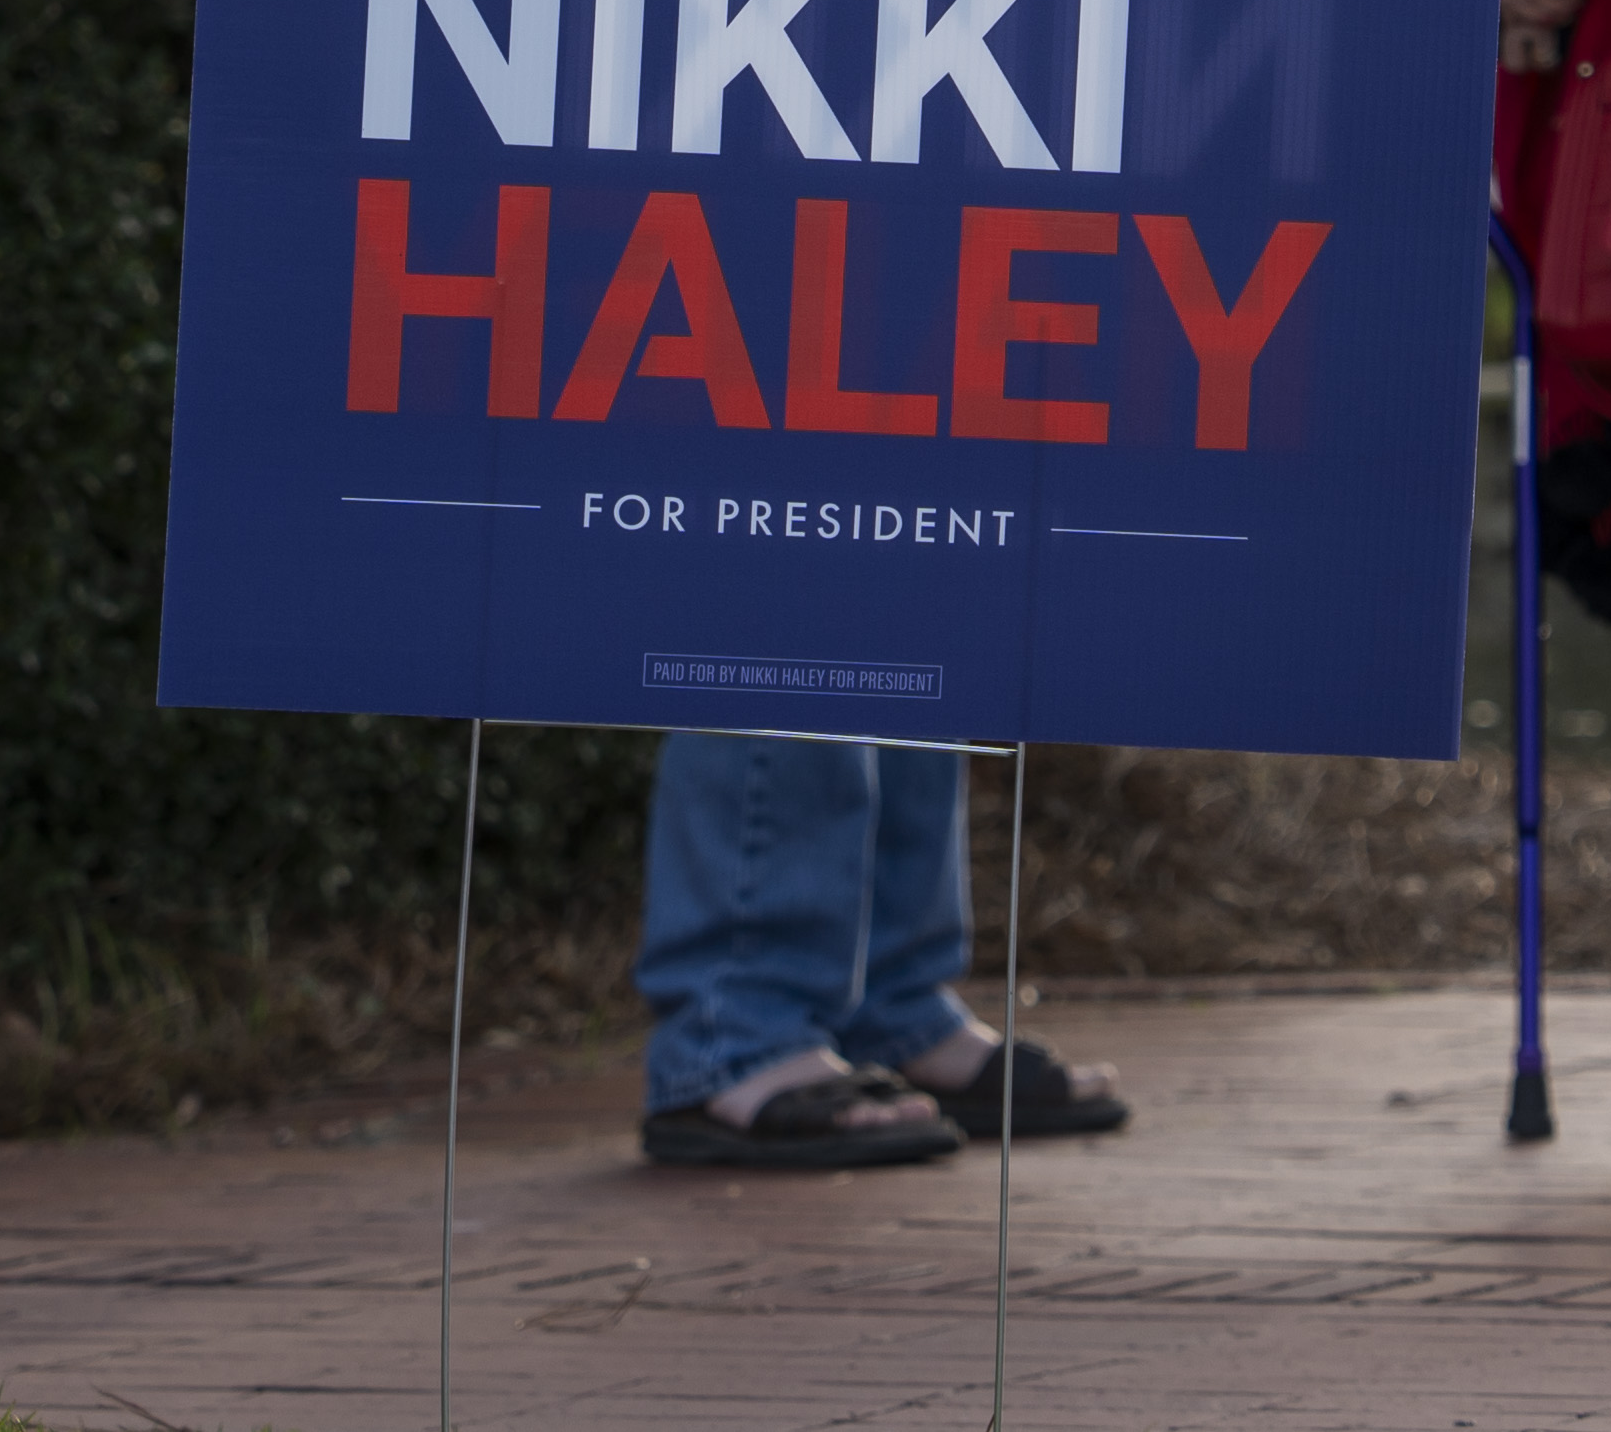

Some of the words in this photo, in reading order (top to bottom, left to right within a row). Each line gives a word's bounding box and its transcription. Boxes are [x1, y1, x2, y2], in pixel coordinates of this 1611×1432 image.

[347, 178, 1333, 451] HALEY
[582, 493, 685, 534] FOR
[717, 497, 1017, 548] PRESIDENT
[653, 662, 684, 681] PAID
[689, 664, 715, 682] FOR
[719, 665, 737, 683] BY
[740, 666, 777, 685] NIKKI
[782, 667, 825, 687] HALEY
[829, 669, 855, 688] FOR
[859, 671, 934, 692] PRESIDENT
